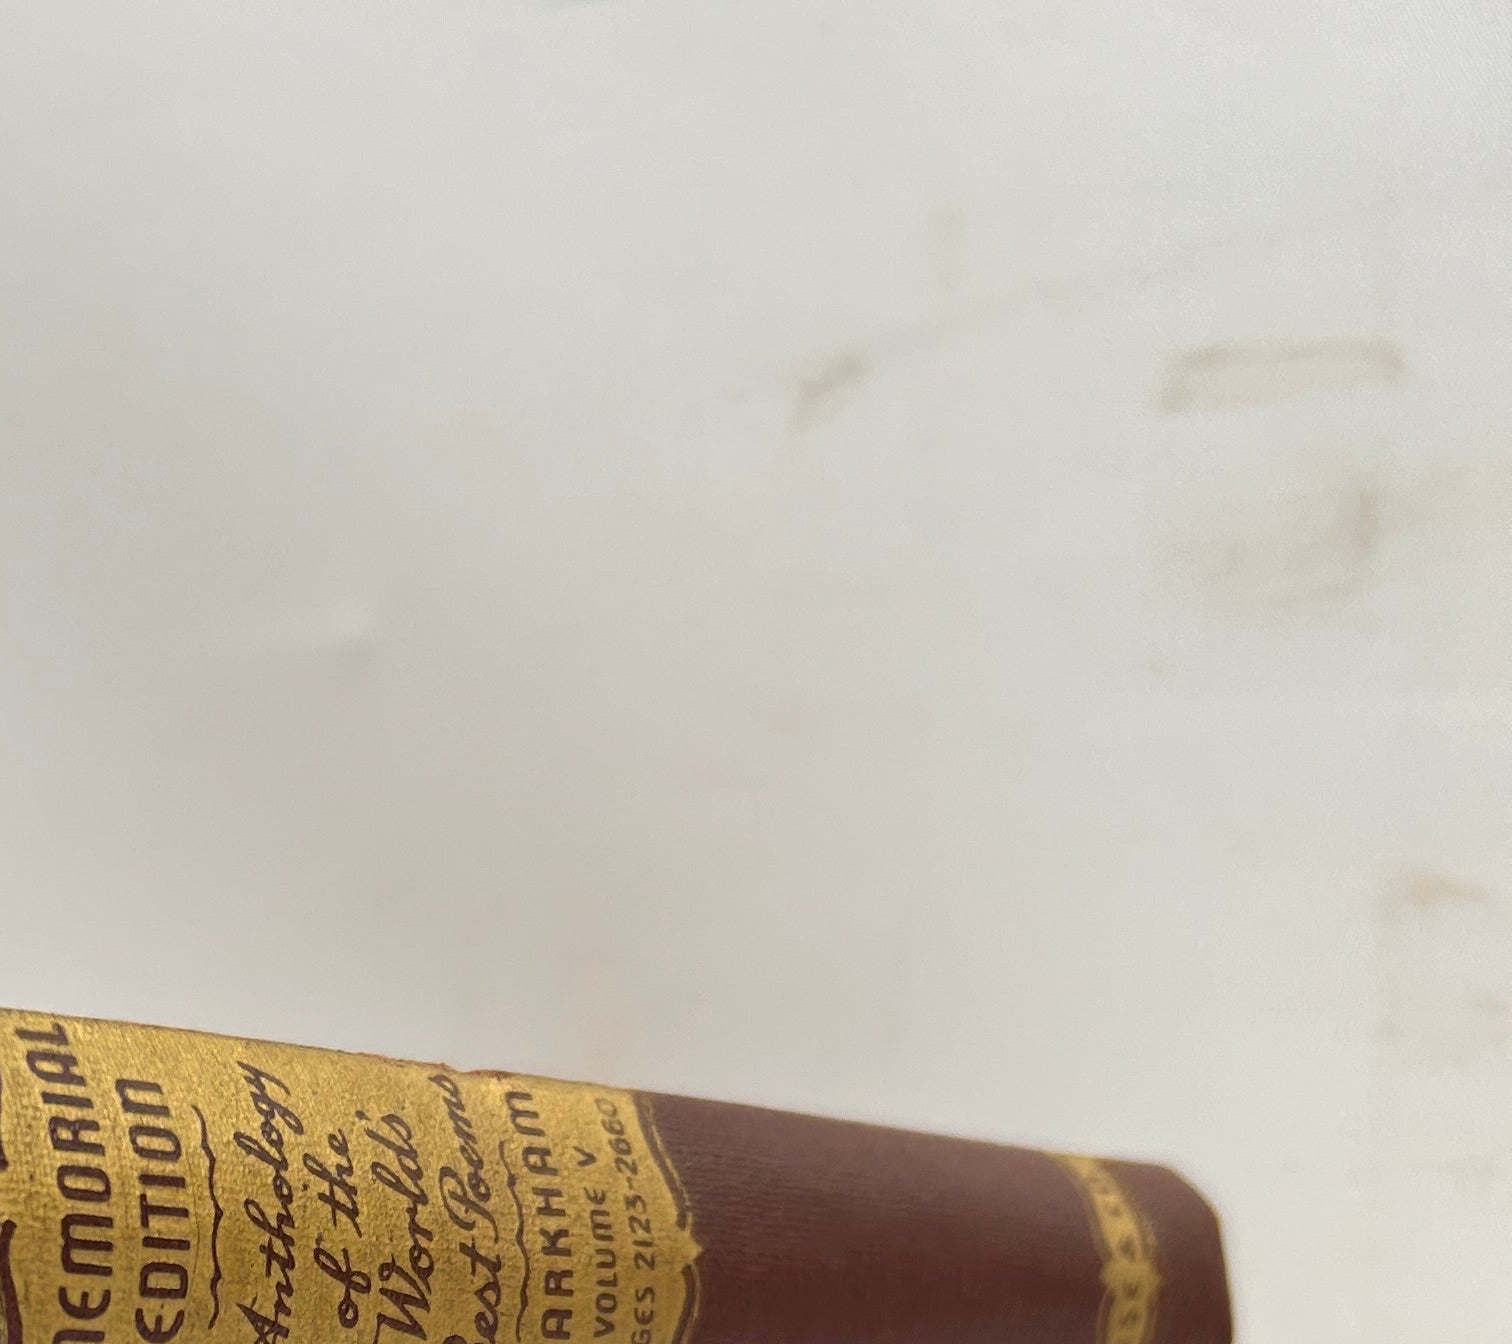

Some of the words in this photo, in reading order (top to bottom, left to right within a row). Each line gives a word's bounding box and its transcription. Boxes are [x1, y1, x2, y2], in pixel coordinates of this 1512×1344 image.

[116, 1078, 189, 1342] EDITION
[301, 1127, 362, 1238] the
[429, 1074, 499, 1244] Poems
[573, 1146, 597, 1168] V
[594, 1097, 656, 1272] 2123-2660
[314, 1233, 372, 1329] of
[585, 1186, 618, 1338] VOLUME
